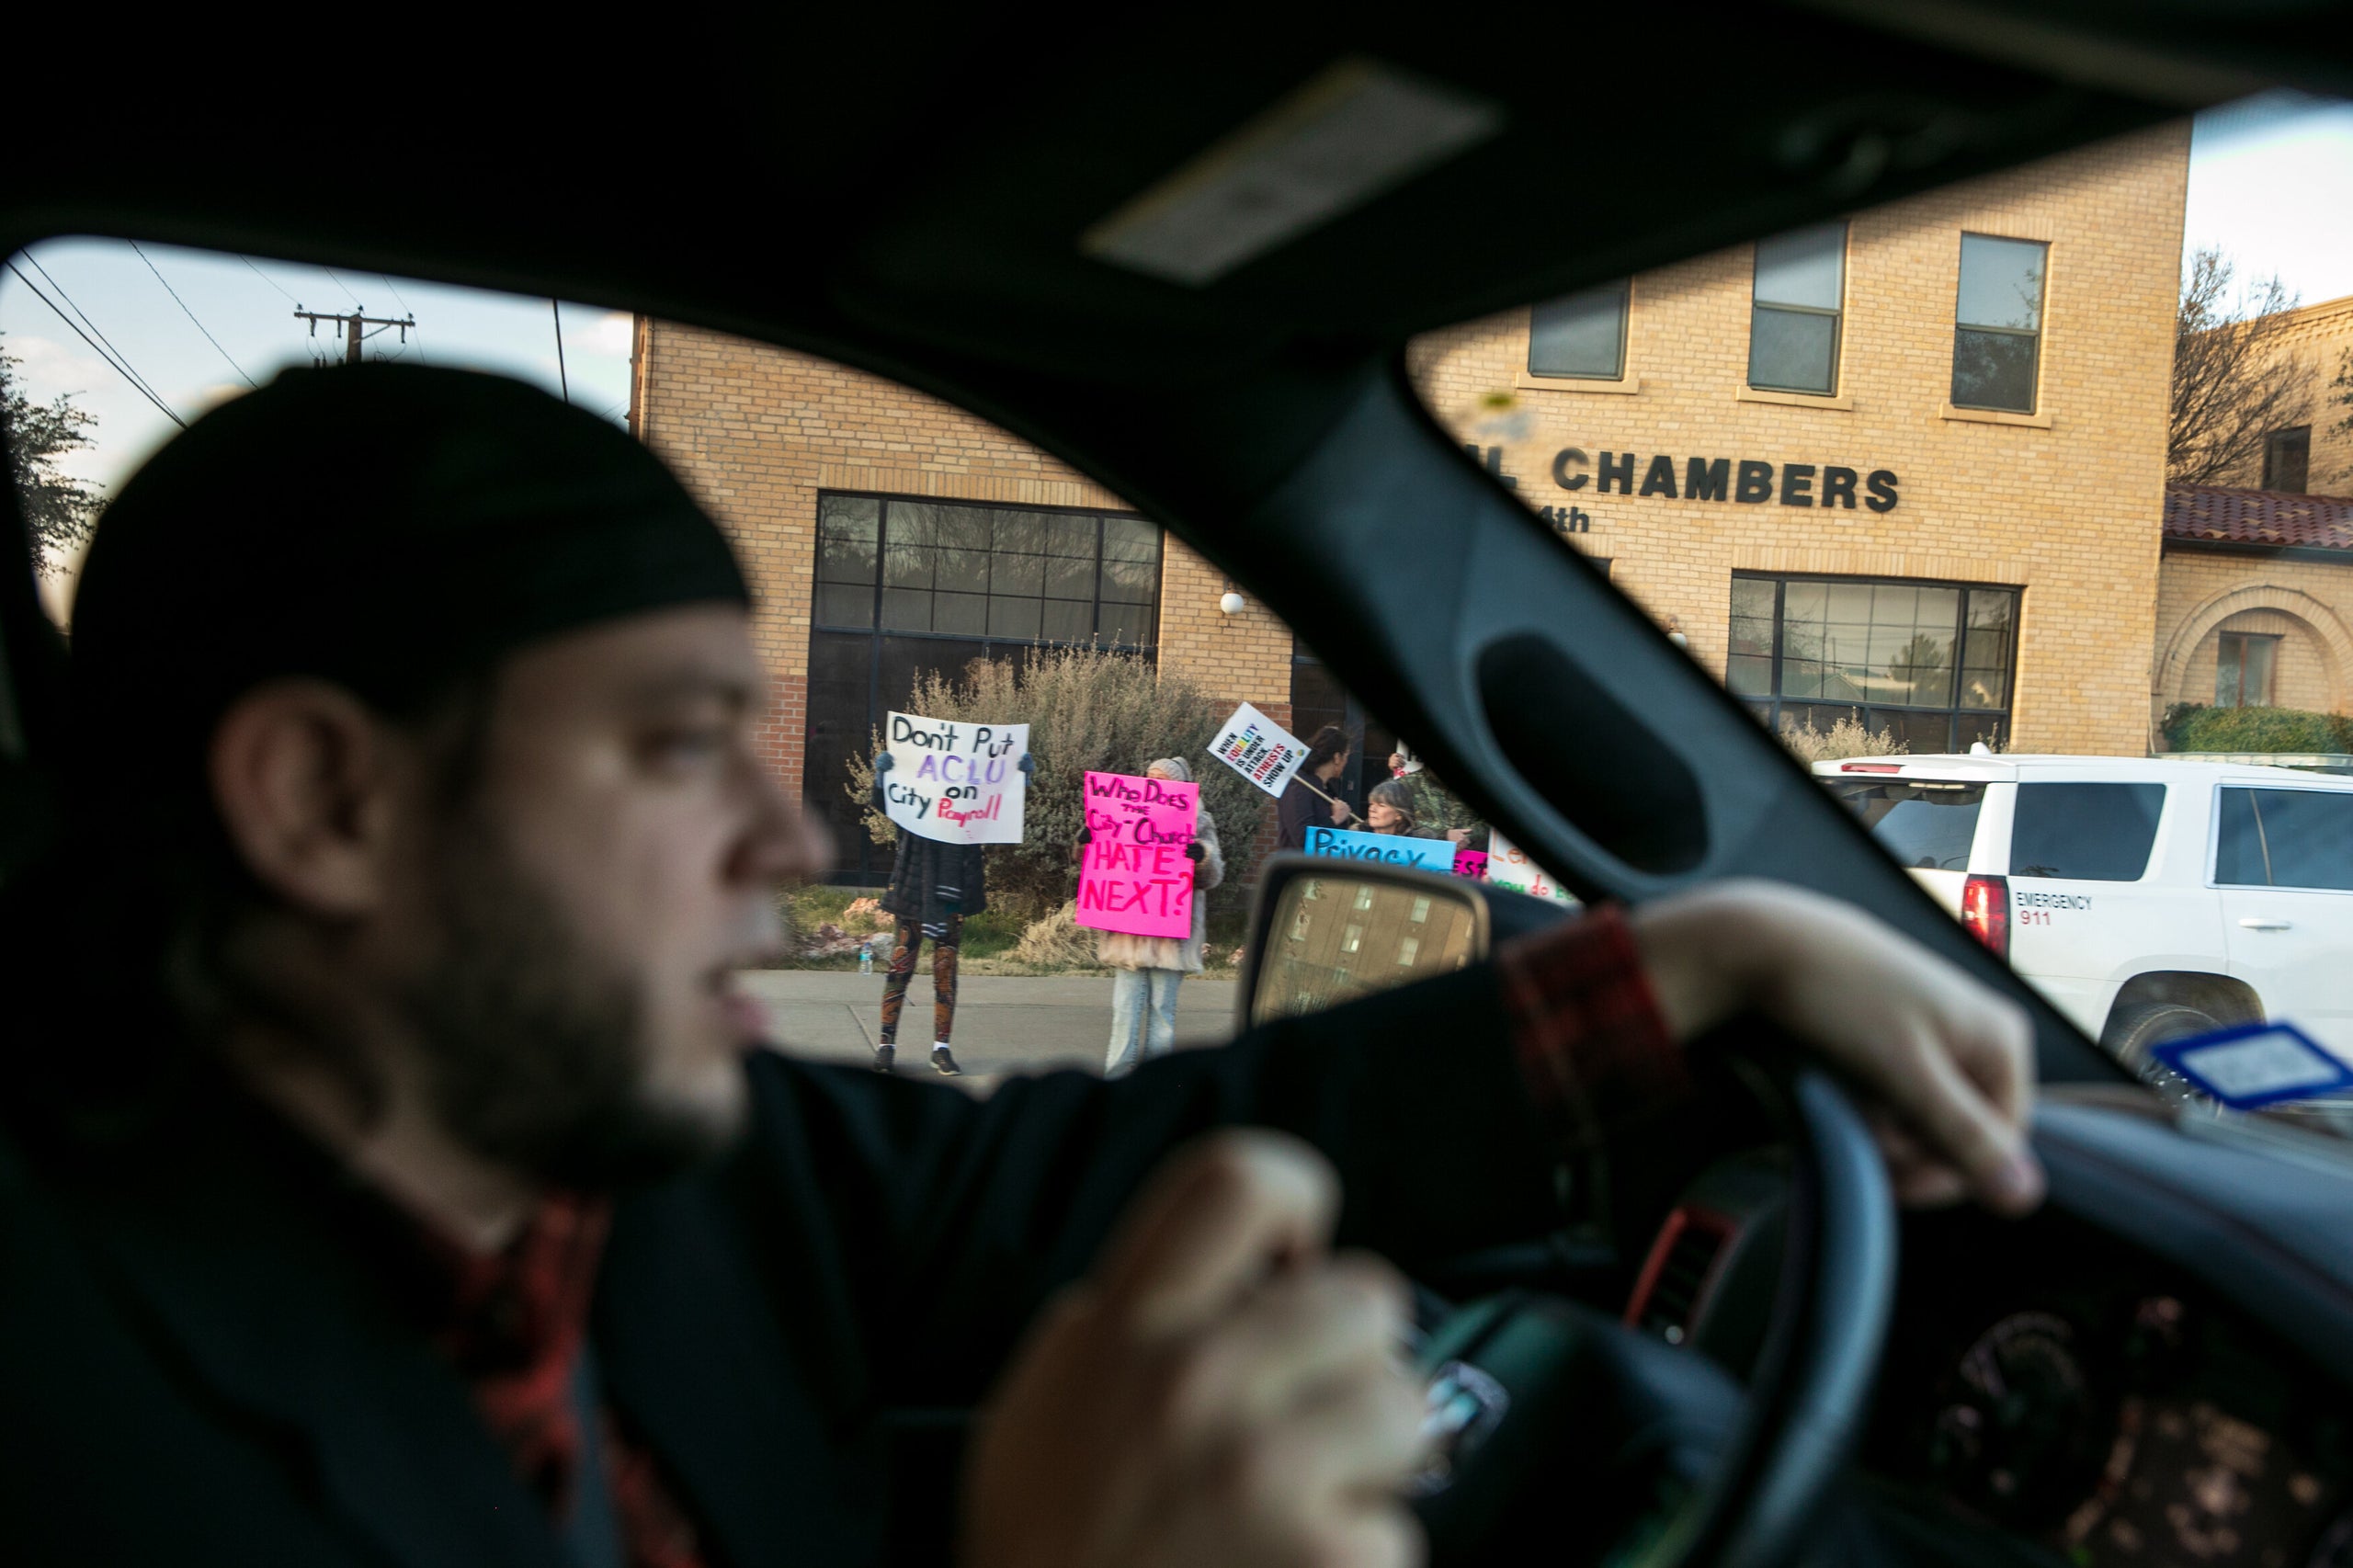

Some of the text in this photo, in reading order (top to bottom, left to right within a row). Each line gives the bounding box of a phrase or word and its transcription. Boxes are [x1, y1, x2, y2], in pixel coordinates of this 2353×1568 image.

[1552, 447, 1899, 513] CHAMBERS
[893, 716, 1014, 758] Don't Put
[1217, 732, 1238, 755] WHEN
[1226, 723, 1259, 762] EQUALITY
[1235, 735, 1266, 767] IS UNDER
[915, 755, 1006, 785] ACLU
[1253, 743, 1286, 781] ATHEISTS
[1263, 762, 1286, 788] SHOW
[1281, 749, 1294, 764] UP
[888, 783, 1003, 828] City Payroll
[945, 786, 978, 800] on
[1089, 776, 1142, 803] Who
[1120, 803, 1151, 816] THE
[1094, 840, 1176, 874] HATE
[1315, 828, 1425, 868] Privacy
[1083, 871, 1193, 917] NEXT?
[1530, 874, 1549, 896] do
[2016, 892, 2092, 910] EMERGENCY
[2020, 910, 2051, 926] 911
